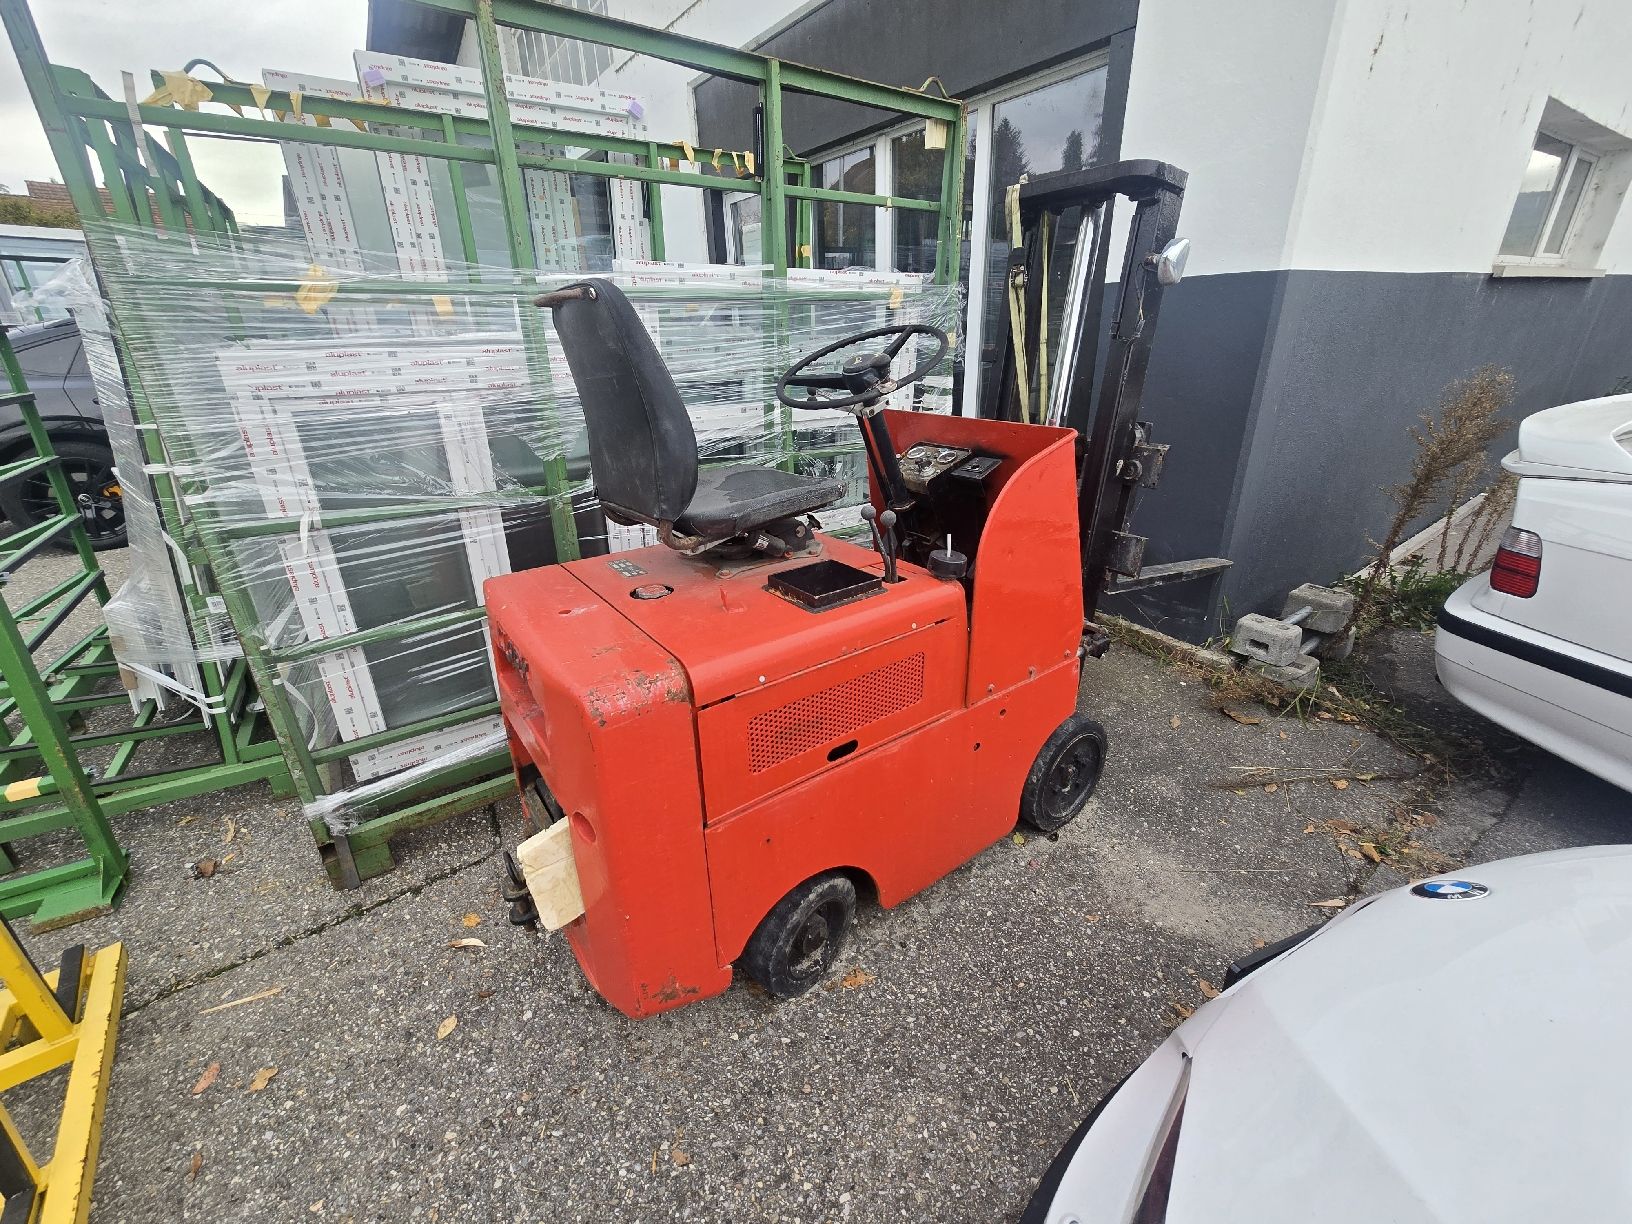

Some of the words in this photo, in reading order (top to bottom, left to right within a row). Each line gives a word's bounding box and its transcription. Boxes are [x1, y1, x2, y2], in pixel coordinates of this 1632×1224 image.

[286, 564, 299, 592] aluplast
[325, 681, 337, 704] aluplast
[396, 745, 425, 758] aluplast
